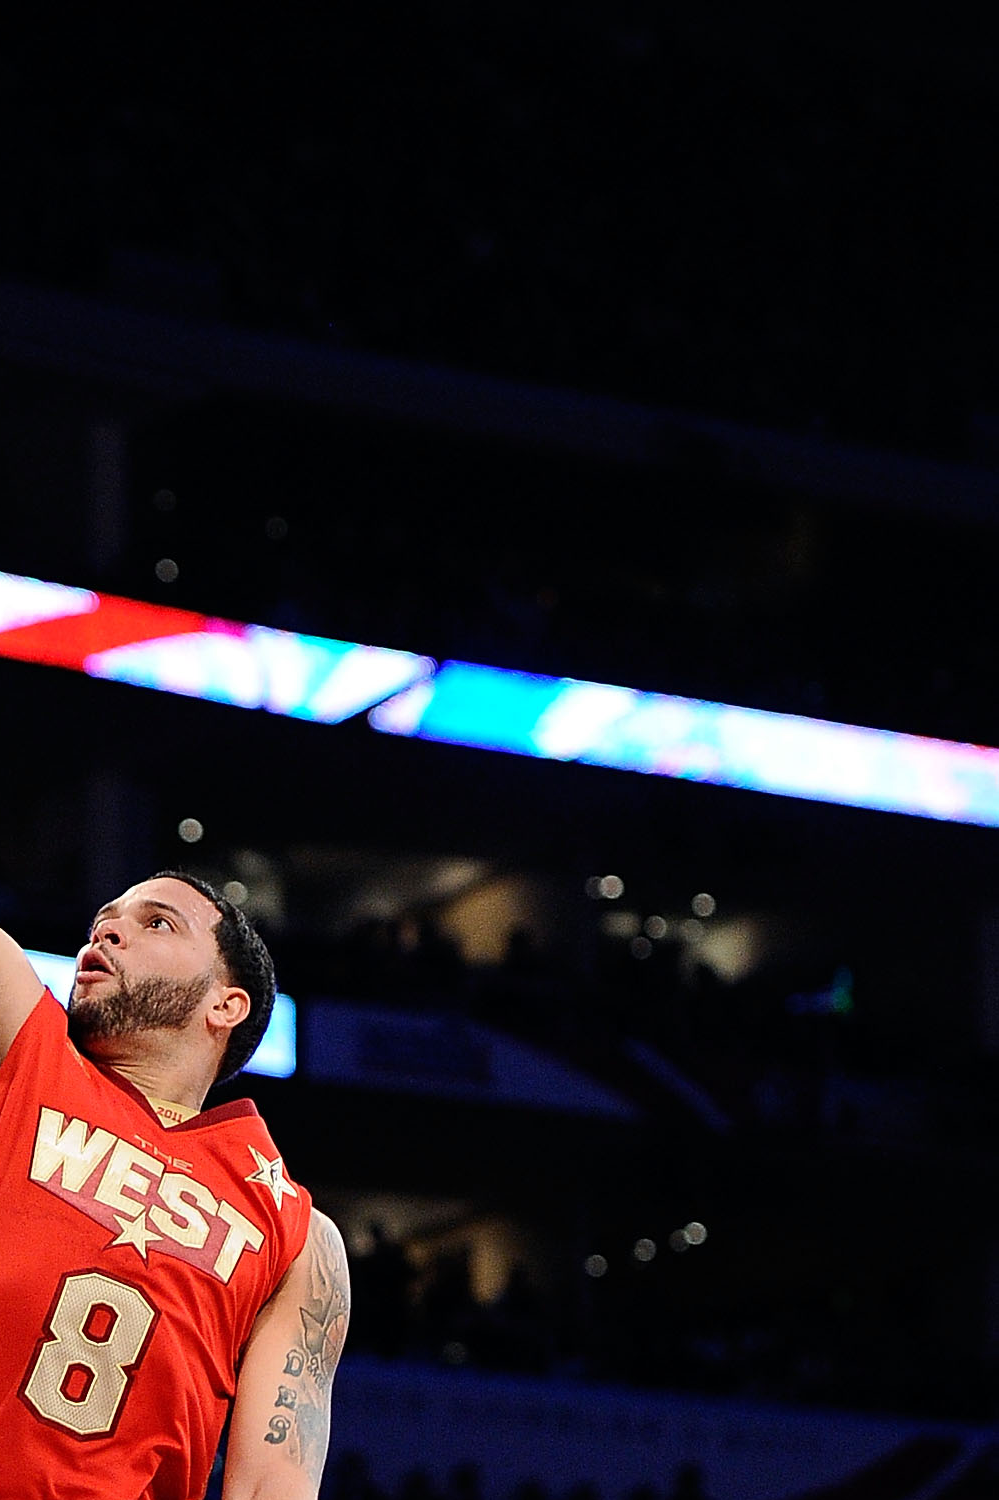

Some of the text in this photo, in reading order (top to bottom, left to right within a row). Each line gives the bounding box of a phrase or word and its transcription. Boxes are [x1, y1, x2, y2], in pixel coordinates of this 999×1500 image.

[133, 1133, 194, 1174] THE
[155, 1105, 183, 1123] 2011
[28, 1105, 266, 1286] WEST
[16, 1267, 161, 1442] 8
